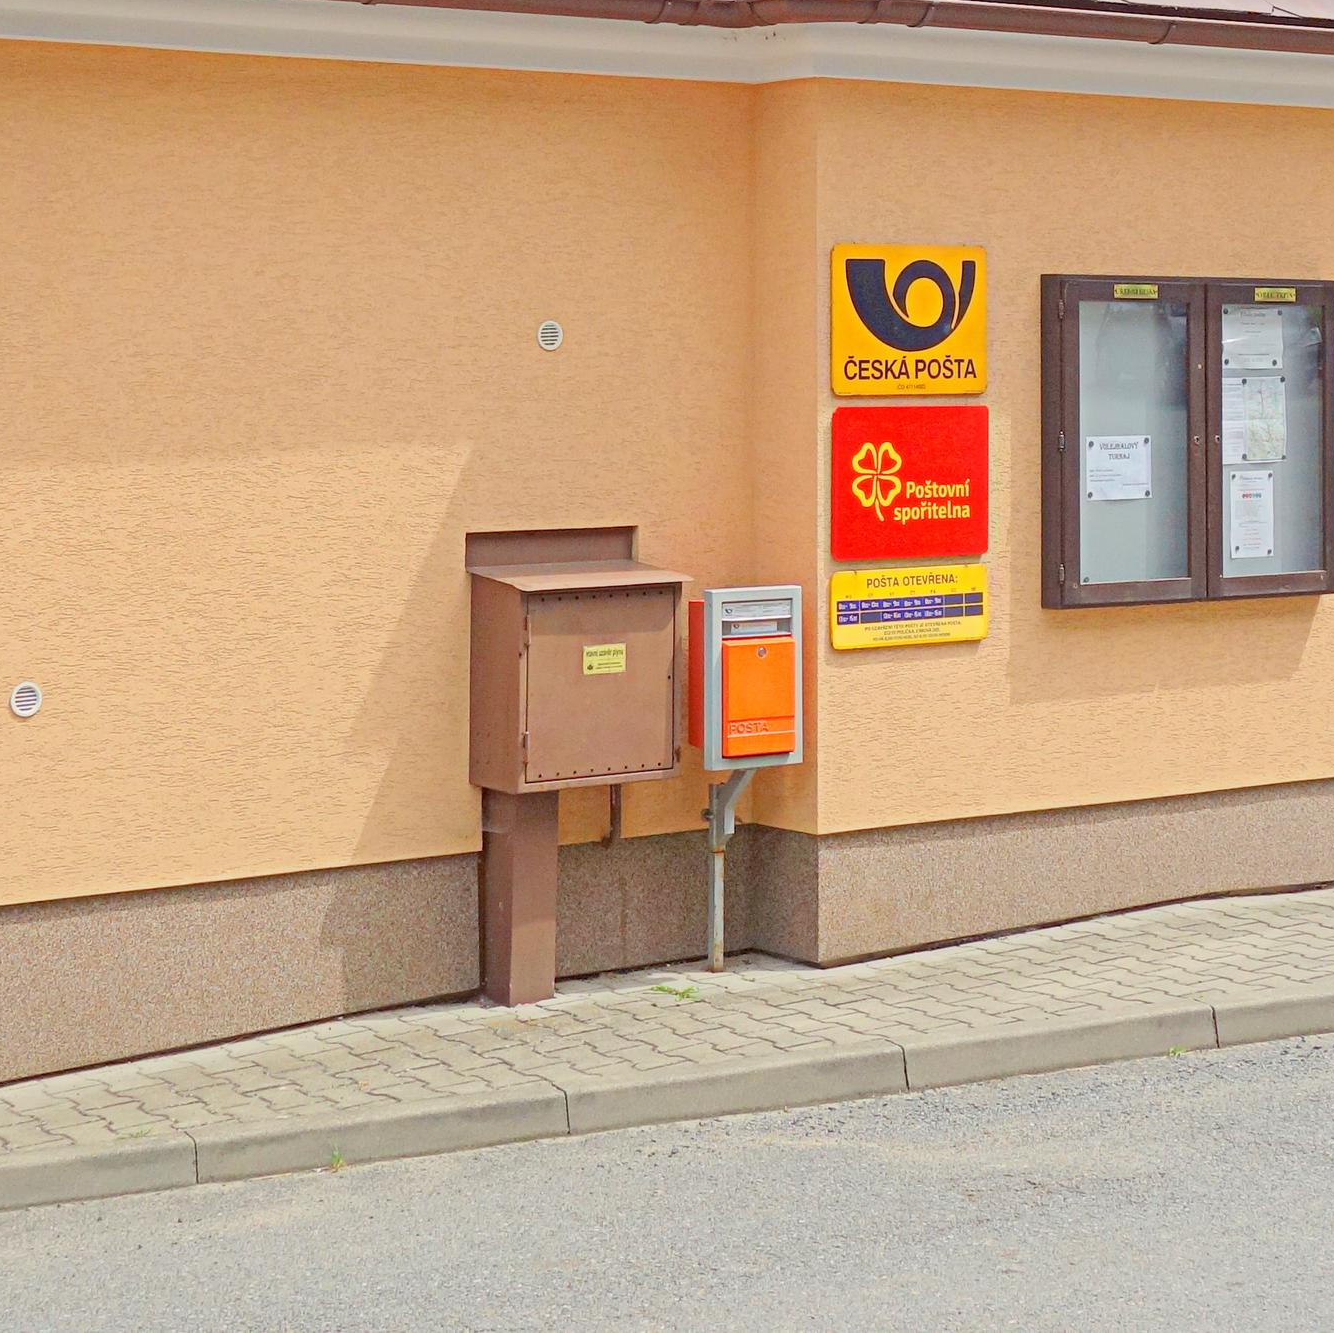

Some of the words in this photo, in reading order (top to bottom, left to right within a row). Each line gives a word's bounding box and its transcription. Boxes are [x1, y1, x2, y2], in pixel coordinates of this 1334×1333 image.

[844, 355, 910, 380] ČESKÁ
[915, 355, 977, 379] POŠTA
[906, 478, 970, 499] Poštovní
[893, 500, 970, 525] spořitelna
[866, 574, 900, 588] POŠTA
[902, 571, 959, 586] OTEVŘENA:
